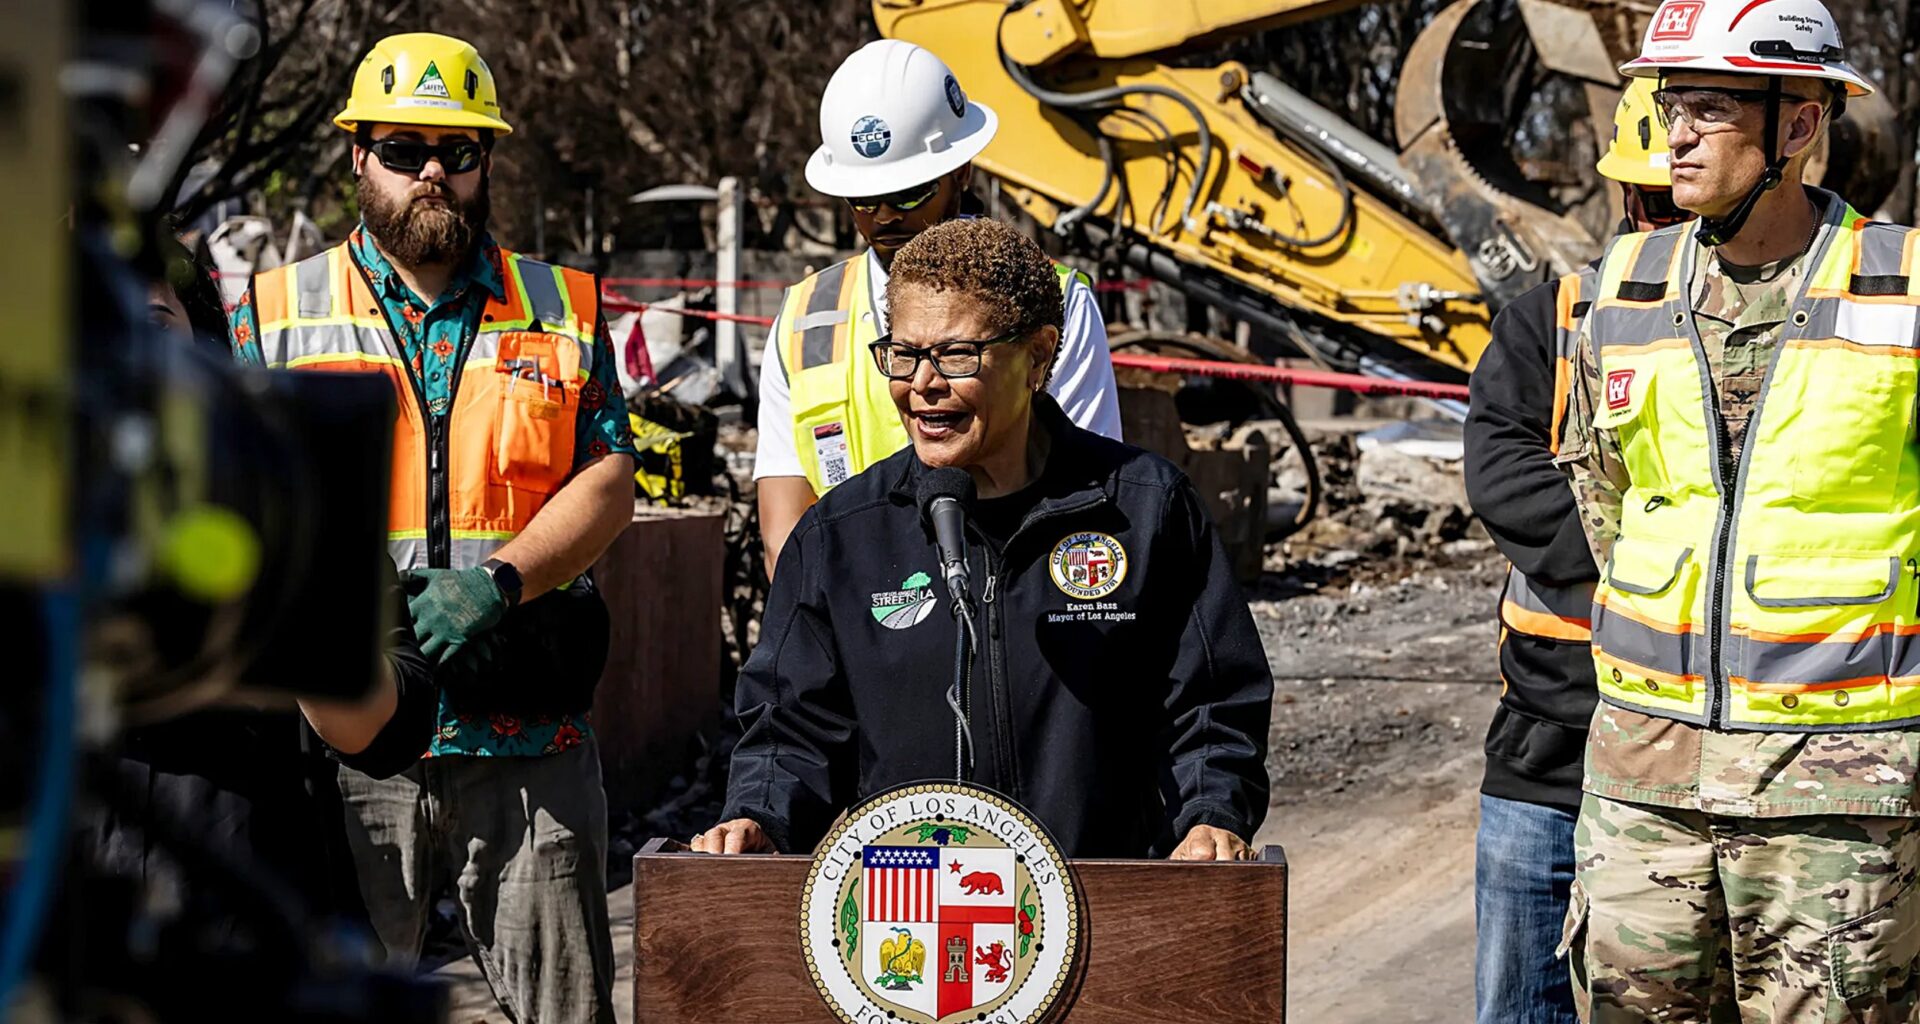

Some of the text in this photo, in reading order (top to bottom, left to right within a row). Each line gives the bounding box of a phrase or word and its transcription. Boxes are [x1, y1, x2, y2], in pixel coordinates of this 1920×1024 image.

[1779, 15, 1823, 27] Building Strong
[1795, 24, 1813, 34] Safely
[423, 84, 444, 92] SAFETY
[858, 133, 882, 143] ECC
[1074, 533, 1092, 542] LOS
[1095, 535, 1124, 562] ANGELES
[1062, 579, 1118, 597] FOUNDED 1781
[872, 588, 935, 607] STREETS LA
[1066, 602, 1118, 611] Karen Bass
[1048, 611, 1136, 622] Mayor of Los Angeles
[823, 798, 1056, 887] CITY OF LOS ANGELES
